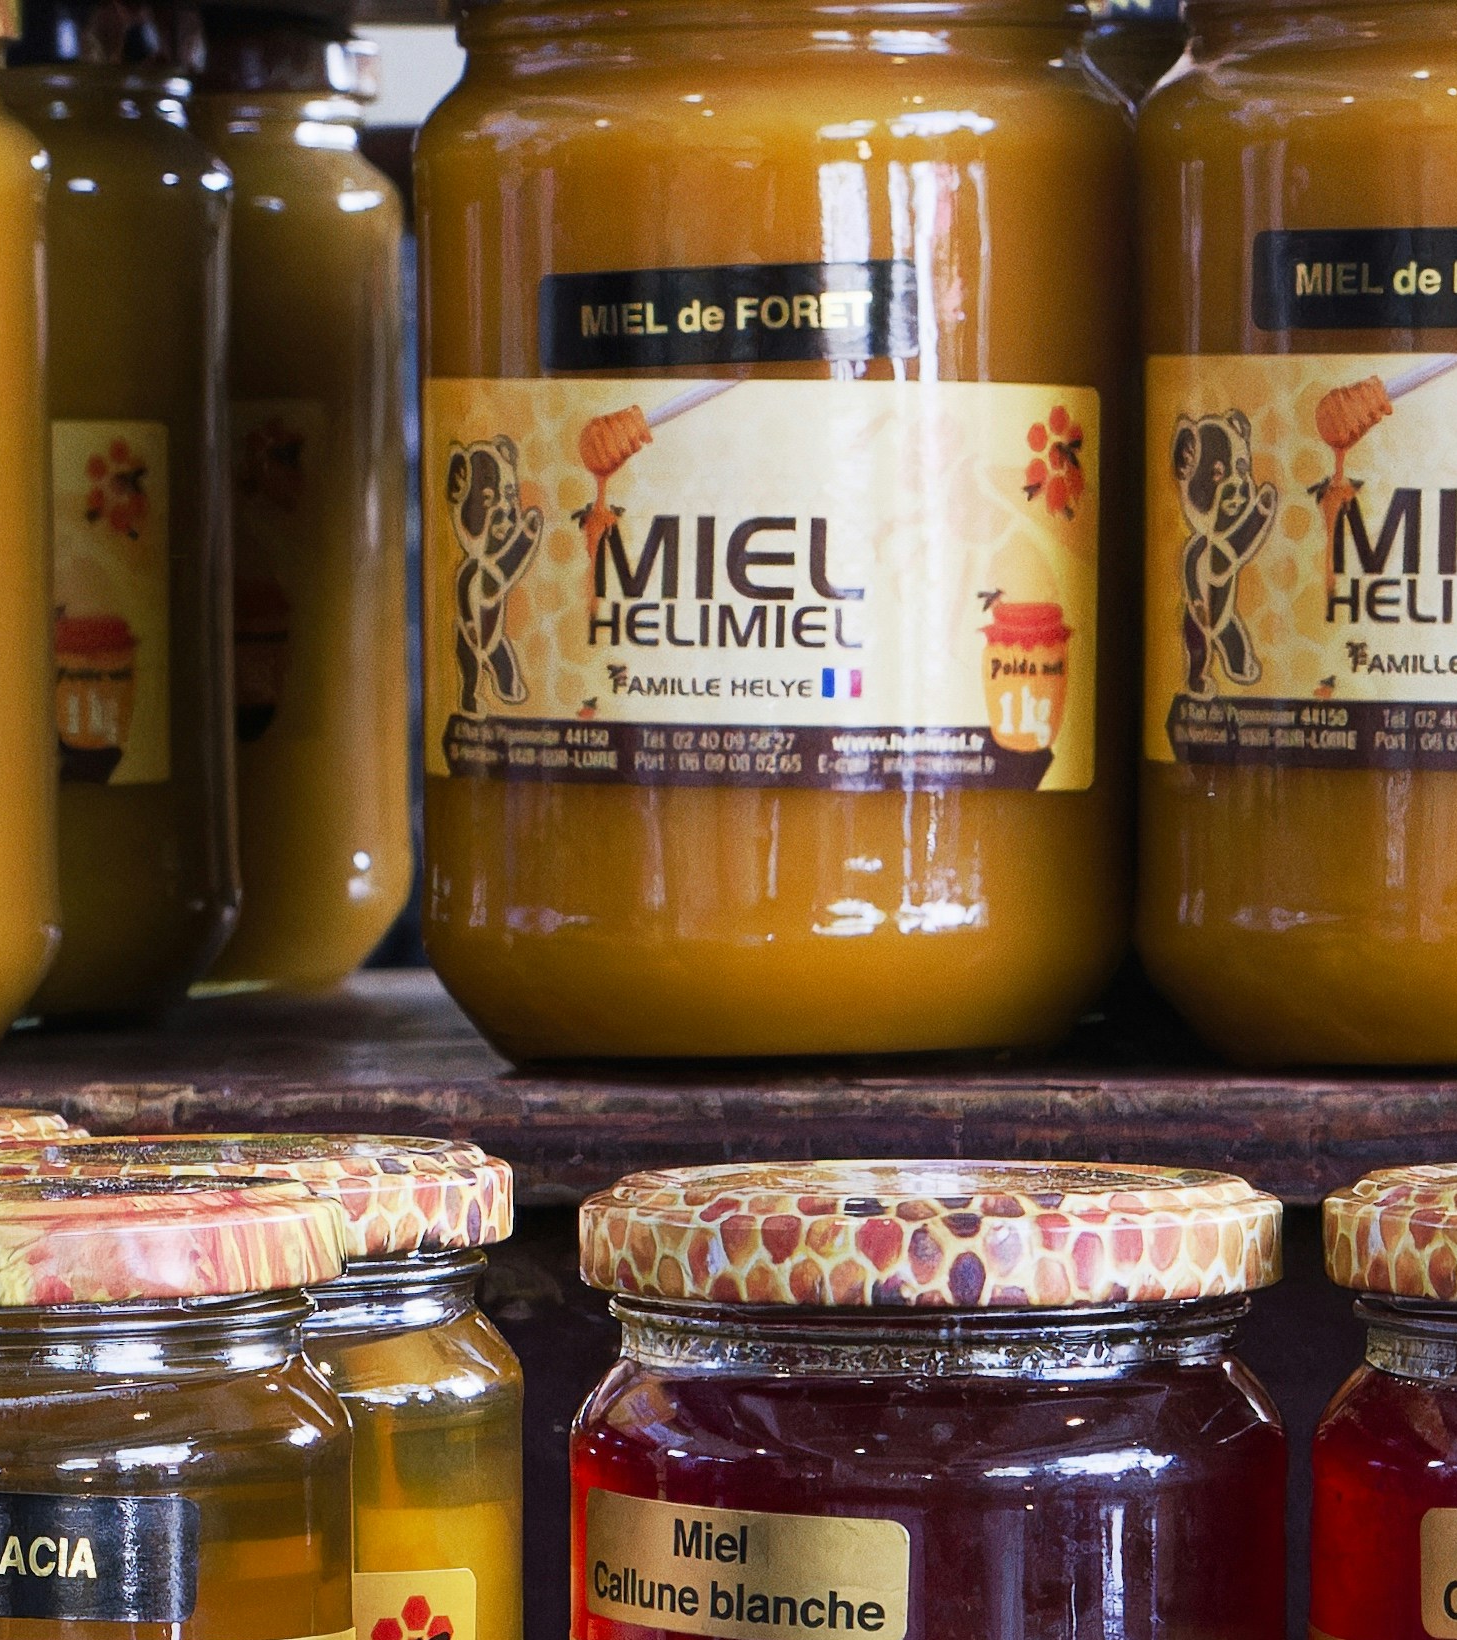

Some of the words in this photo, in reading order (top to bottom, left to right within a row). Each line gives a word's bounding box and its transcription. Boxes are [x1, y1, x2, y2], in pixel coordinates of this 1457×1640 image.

[1296, 262, 1383, 297] MIEL
[1393, 261, 1441, 294] de
[581, 303, 668, 336] MIEL
[678, 300, 724, 332] de
[735, 291, 872, 330] FORET
[593, 516, 865, 600] MIEL
[589, 604, 863, 648] HELIMIEL
[614, 674, 721, 697] FAMILLE
[731, 678, 812, 698] HELYE
[673, 1519, 748, 1565] Miel
[594, 1561, 698, 1616] Callune
[709, 1580, 885, 1631] blanche
